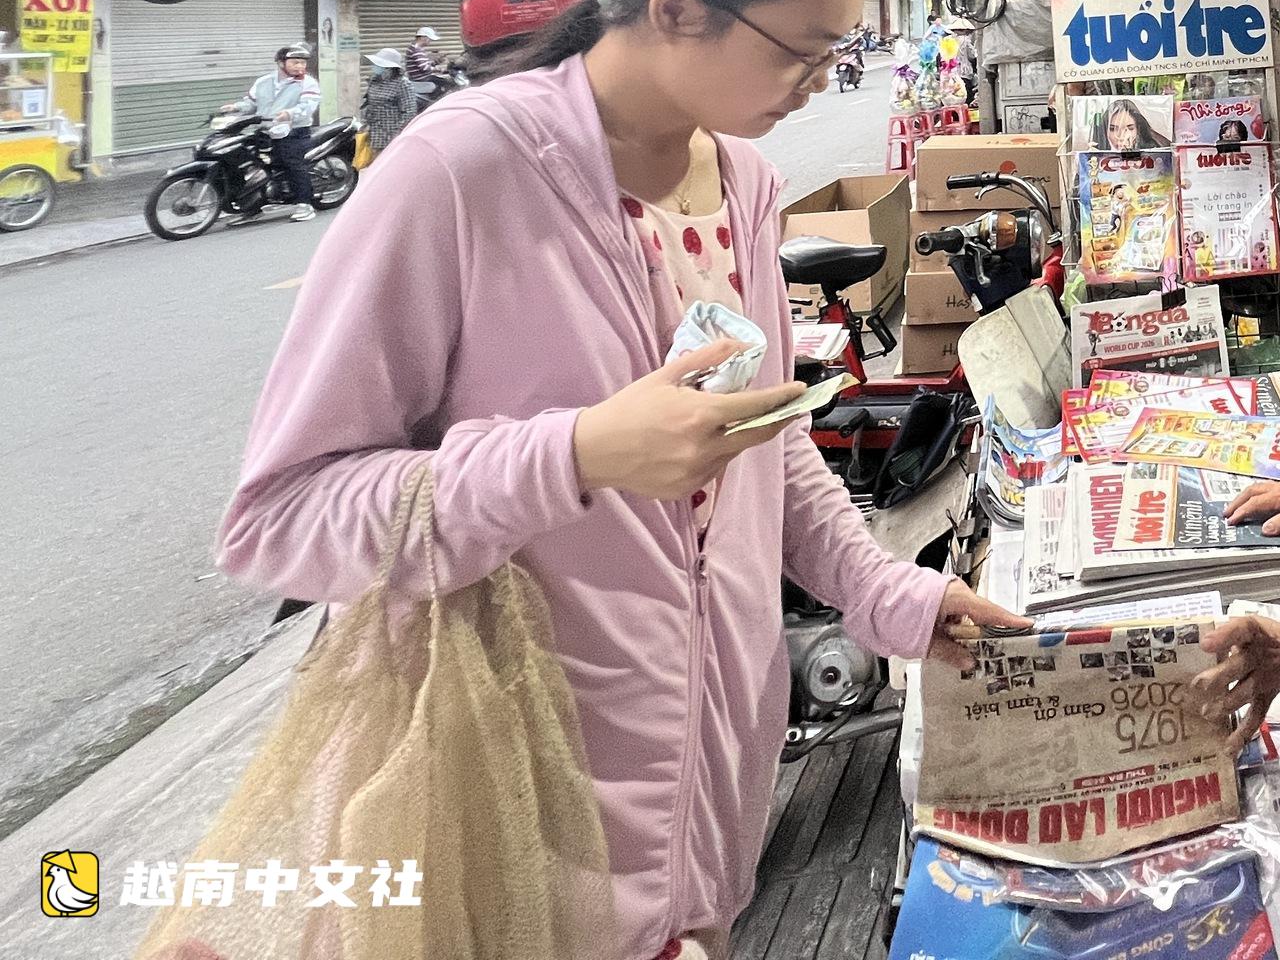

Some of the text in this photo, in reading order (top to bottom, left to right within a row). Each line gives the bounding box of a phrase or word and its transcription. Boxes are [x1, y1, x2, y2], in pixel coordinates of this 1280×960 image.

[1079, 67, 1105, 77] QUAN
[1107, 64, 1125, 75] CỦA
[1154, 62, 1178, 71] TNCS
[1212, 58, 1235, 66] MINH
[1104, 343, 1127, 354] WORLD
[1128, 342, 1139, 352] CUP
[964, 695, 1060, 721] & tạm biệt
[1110, 681, 1185, 710] 2026
[1033, 701, 1106, 721] Cảm ơn
[1115, 709, 1190, 754] 1975
[1116, 772, 1222, 830] NGƯỜI
[932, 808, 1029, 845] ĐỘNG
[1038, 797, 1106, 844] LAO
